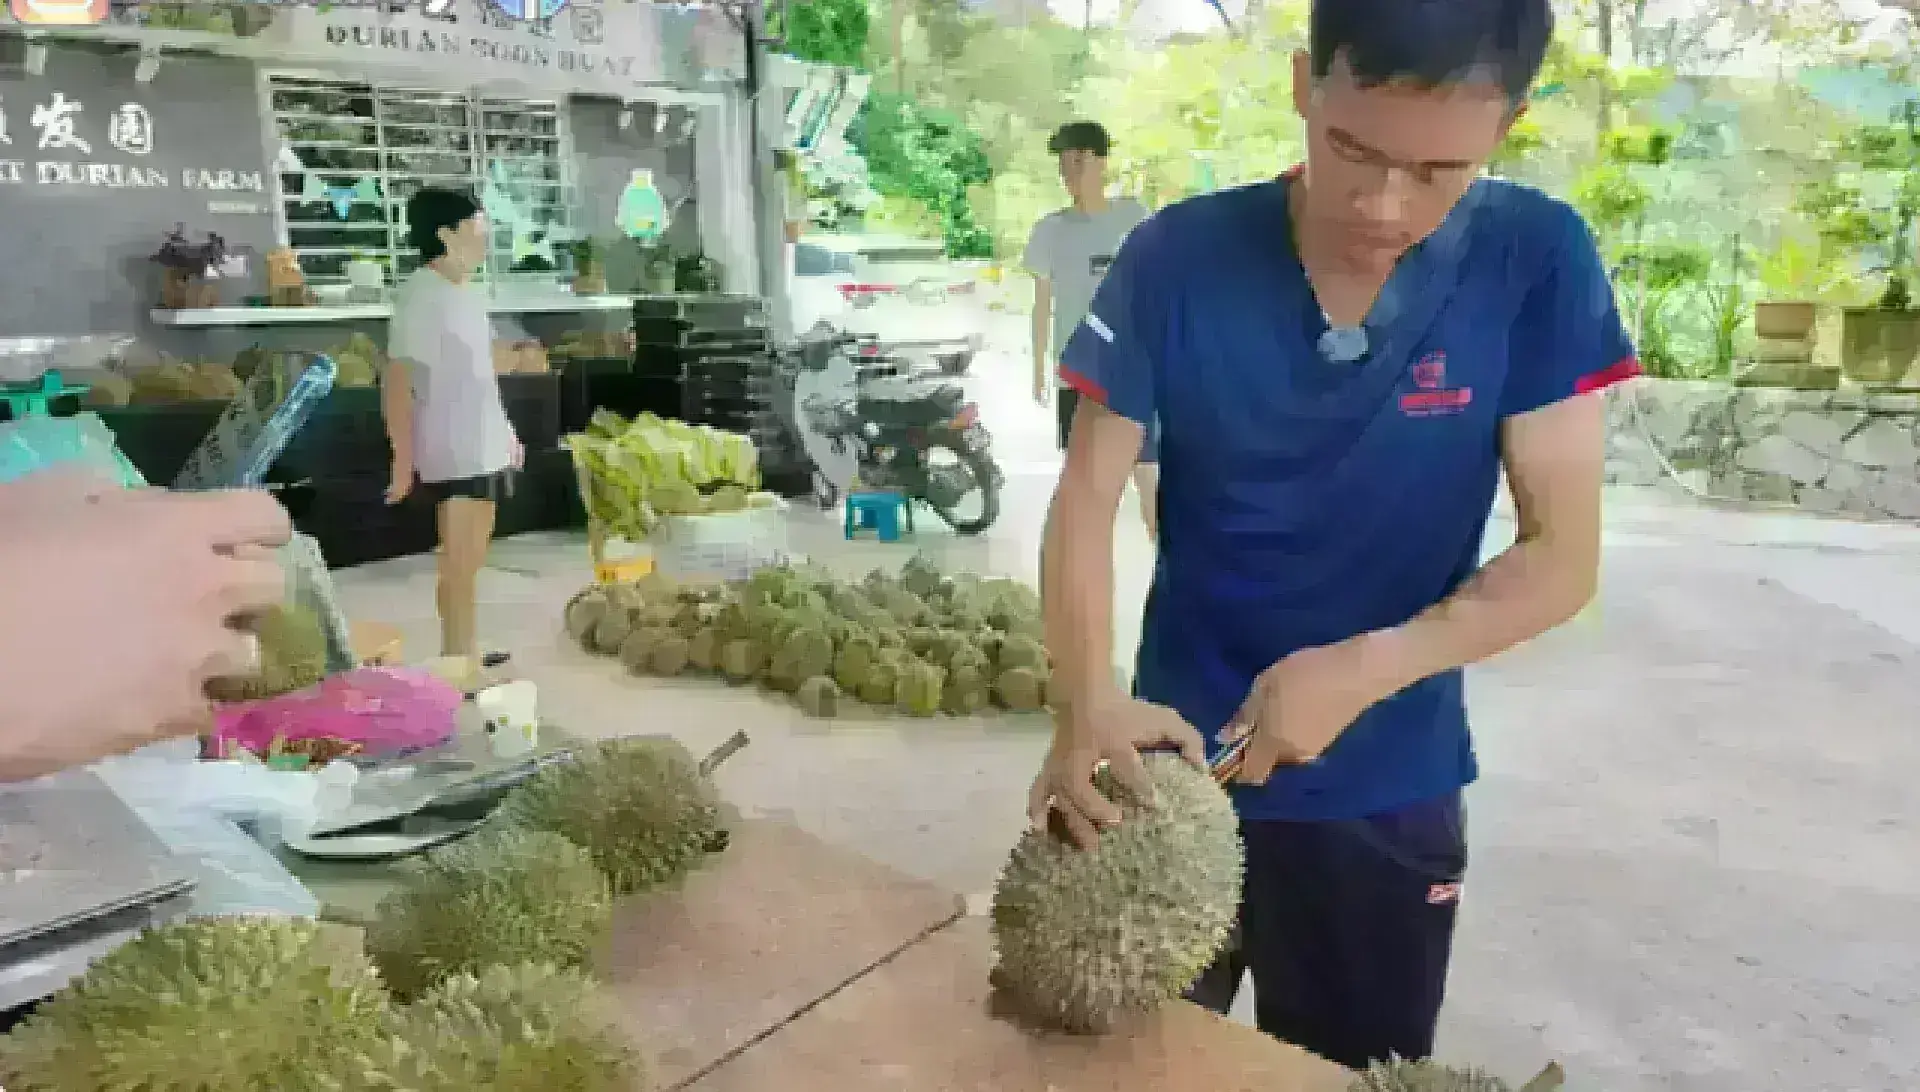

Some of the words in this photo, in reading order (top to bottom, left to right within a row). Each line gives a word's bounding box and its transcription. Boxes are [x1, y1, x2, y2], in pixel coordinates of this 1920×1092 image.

[325, 24, 461, 53] DURIAN
[36, 161, 168, 188] DURIAN
[182, 167, 264, 190] FARM
